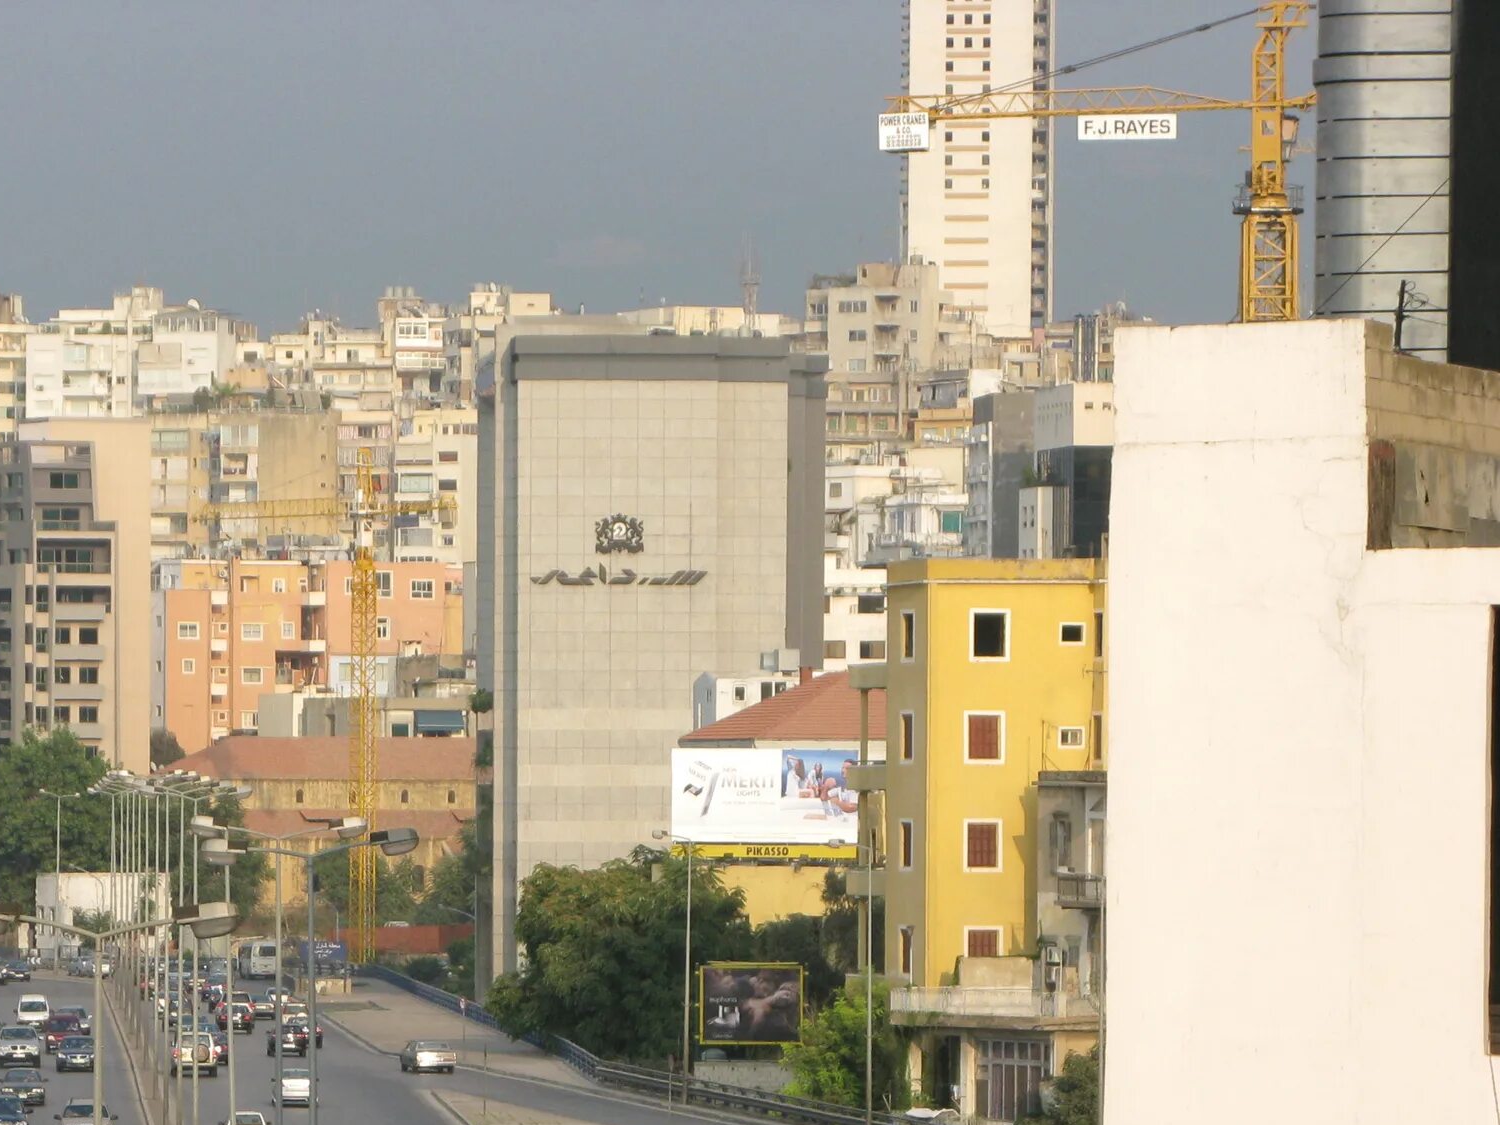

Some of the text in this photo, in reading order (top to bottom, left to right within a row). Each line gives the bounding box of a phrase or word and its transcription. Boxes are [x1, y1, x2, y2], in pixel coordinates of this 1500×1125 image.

[880, 114, 926, 126] POWER CRANES
[746, 846, 789, 856] PIKASSO
